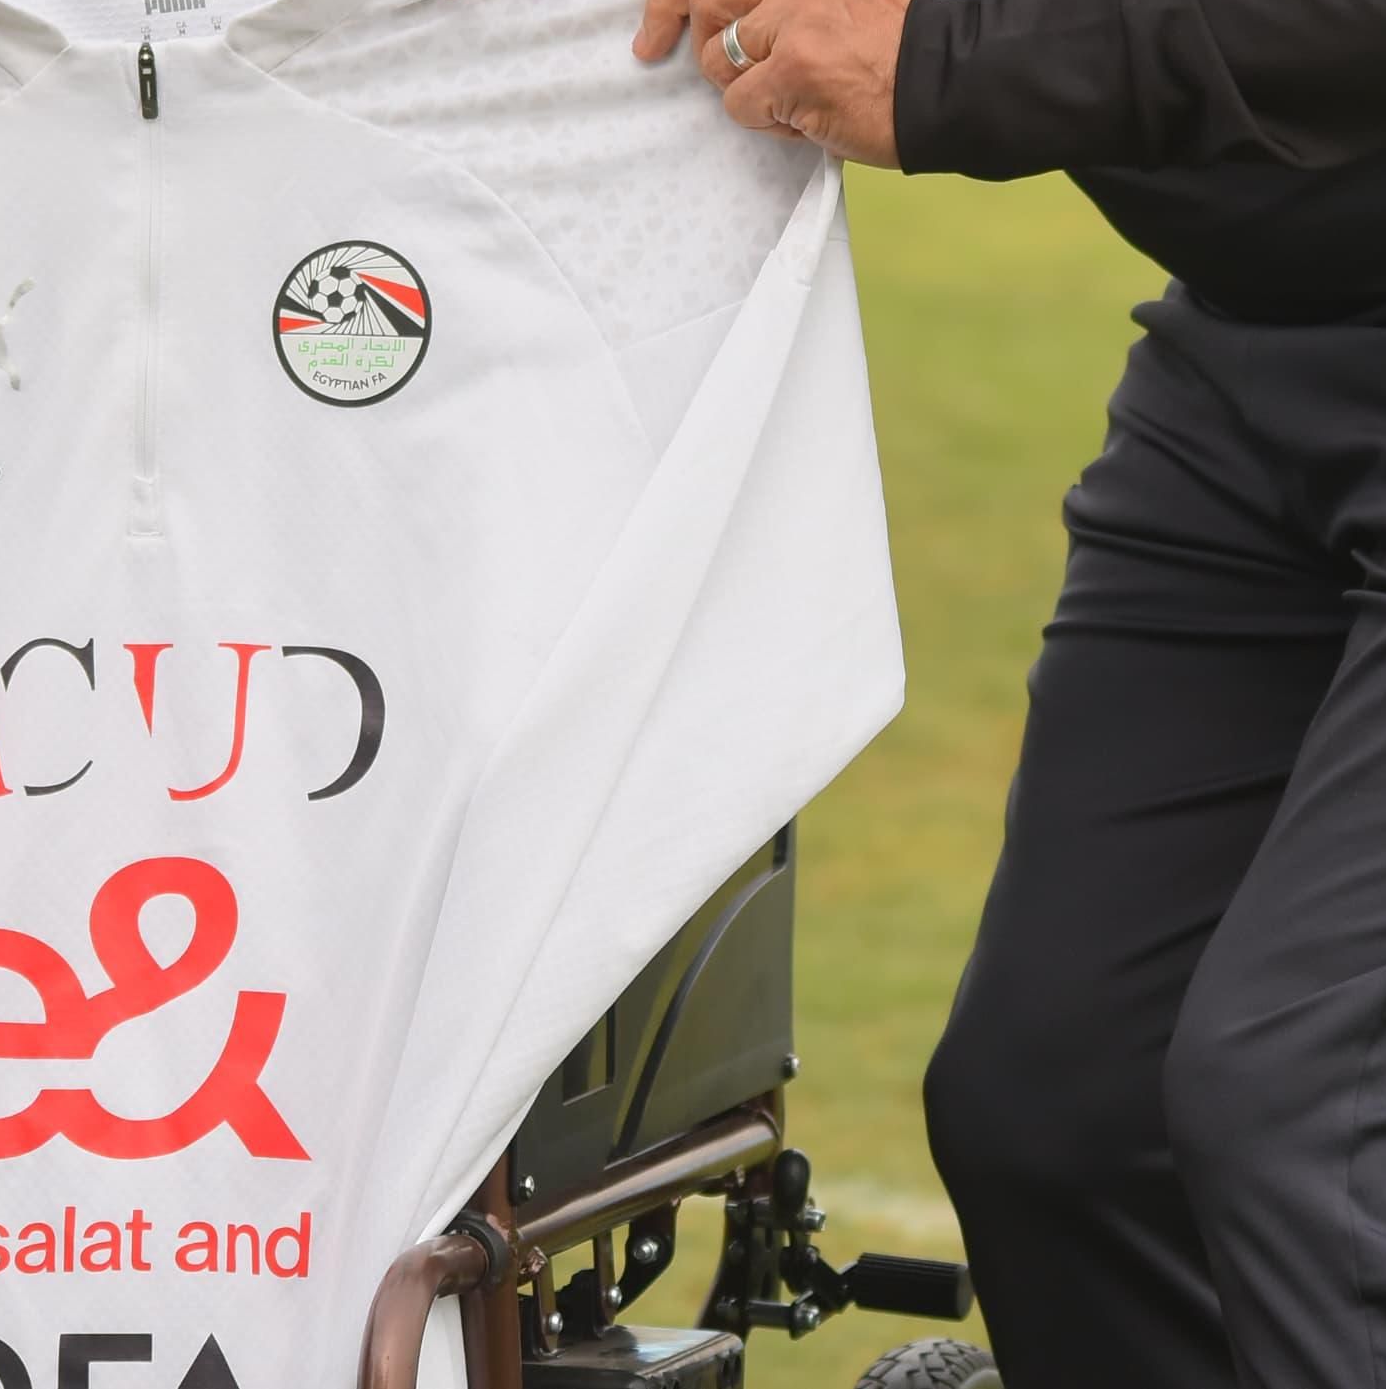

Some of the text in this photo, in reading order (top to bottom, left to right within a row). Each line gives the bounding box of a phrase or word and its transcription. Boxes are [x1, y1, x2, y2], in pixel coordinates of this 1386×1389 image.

[312, 371, 387, 390] EGYPTIAN FA
[175, 1211, 312, 1279] and
